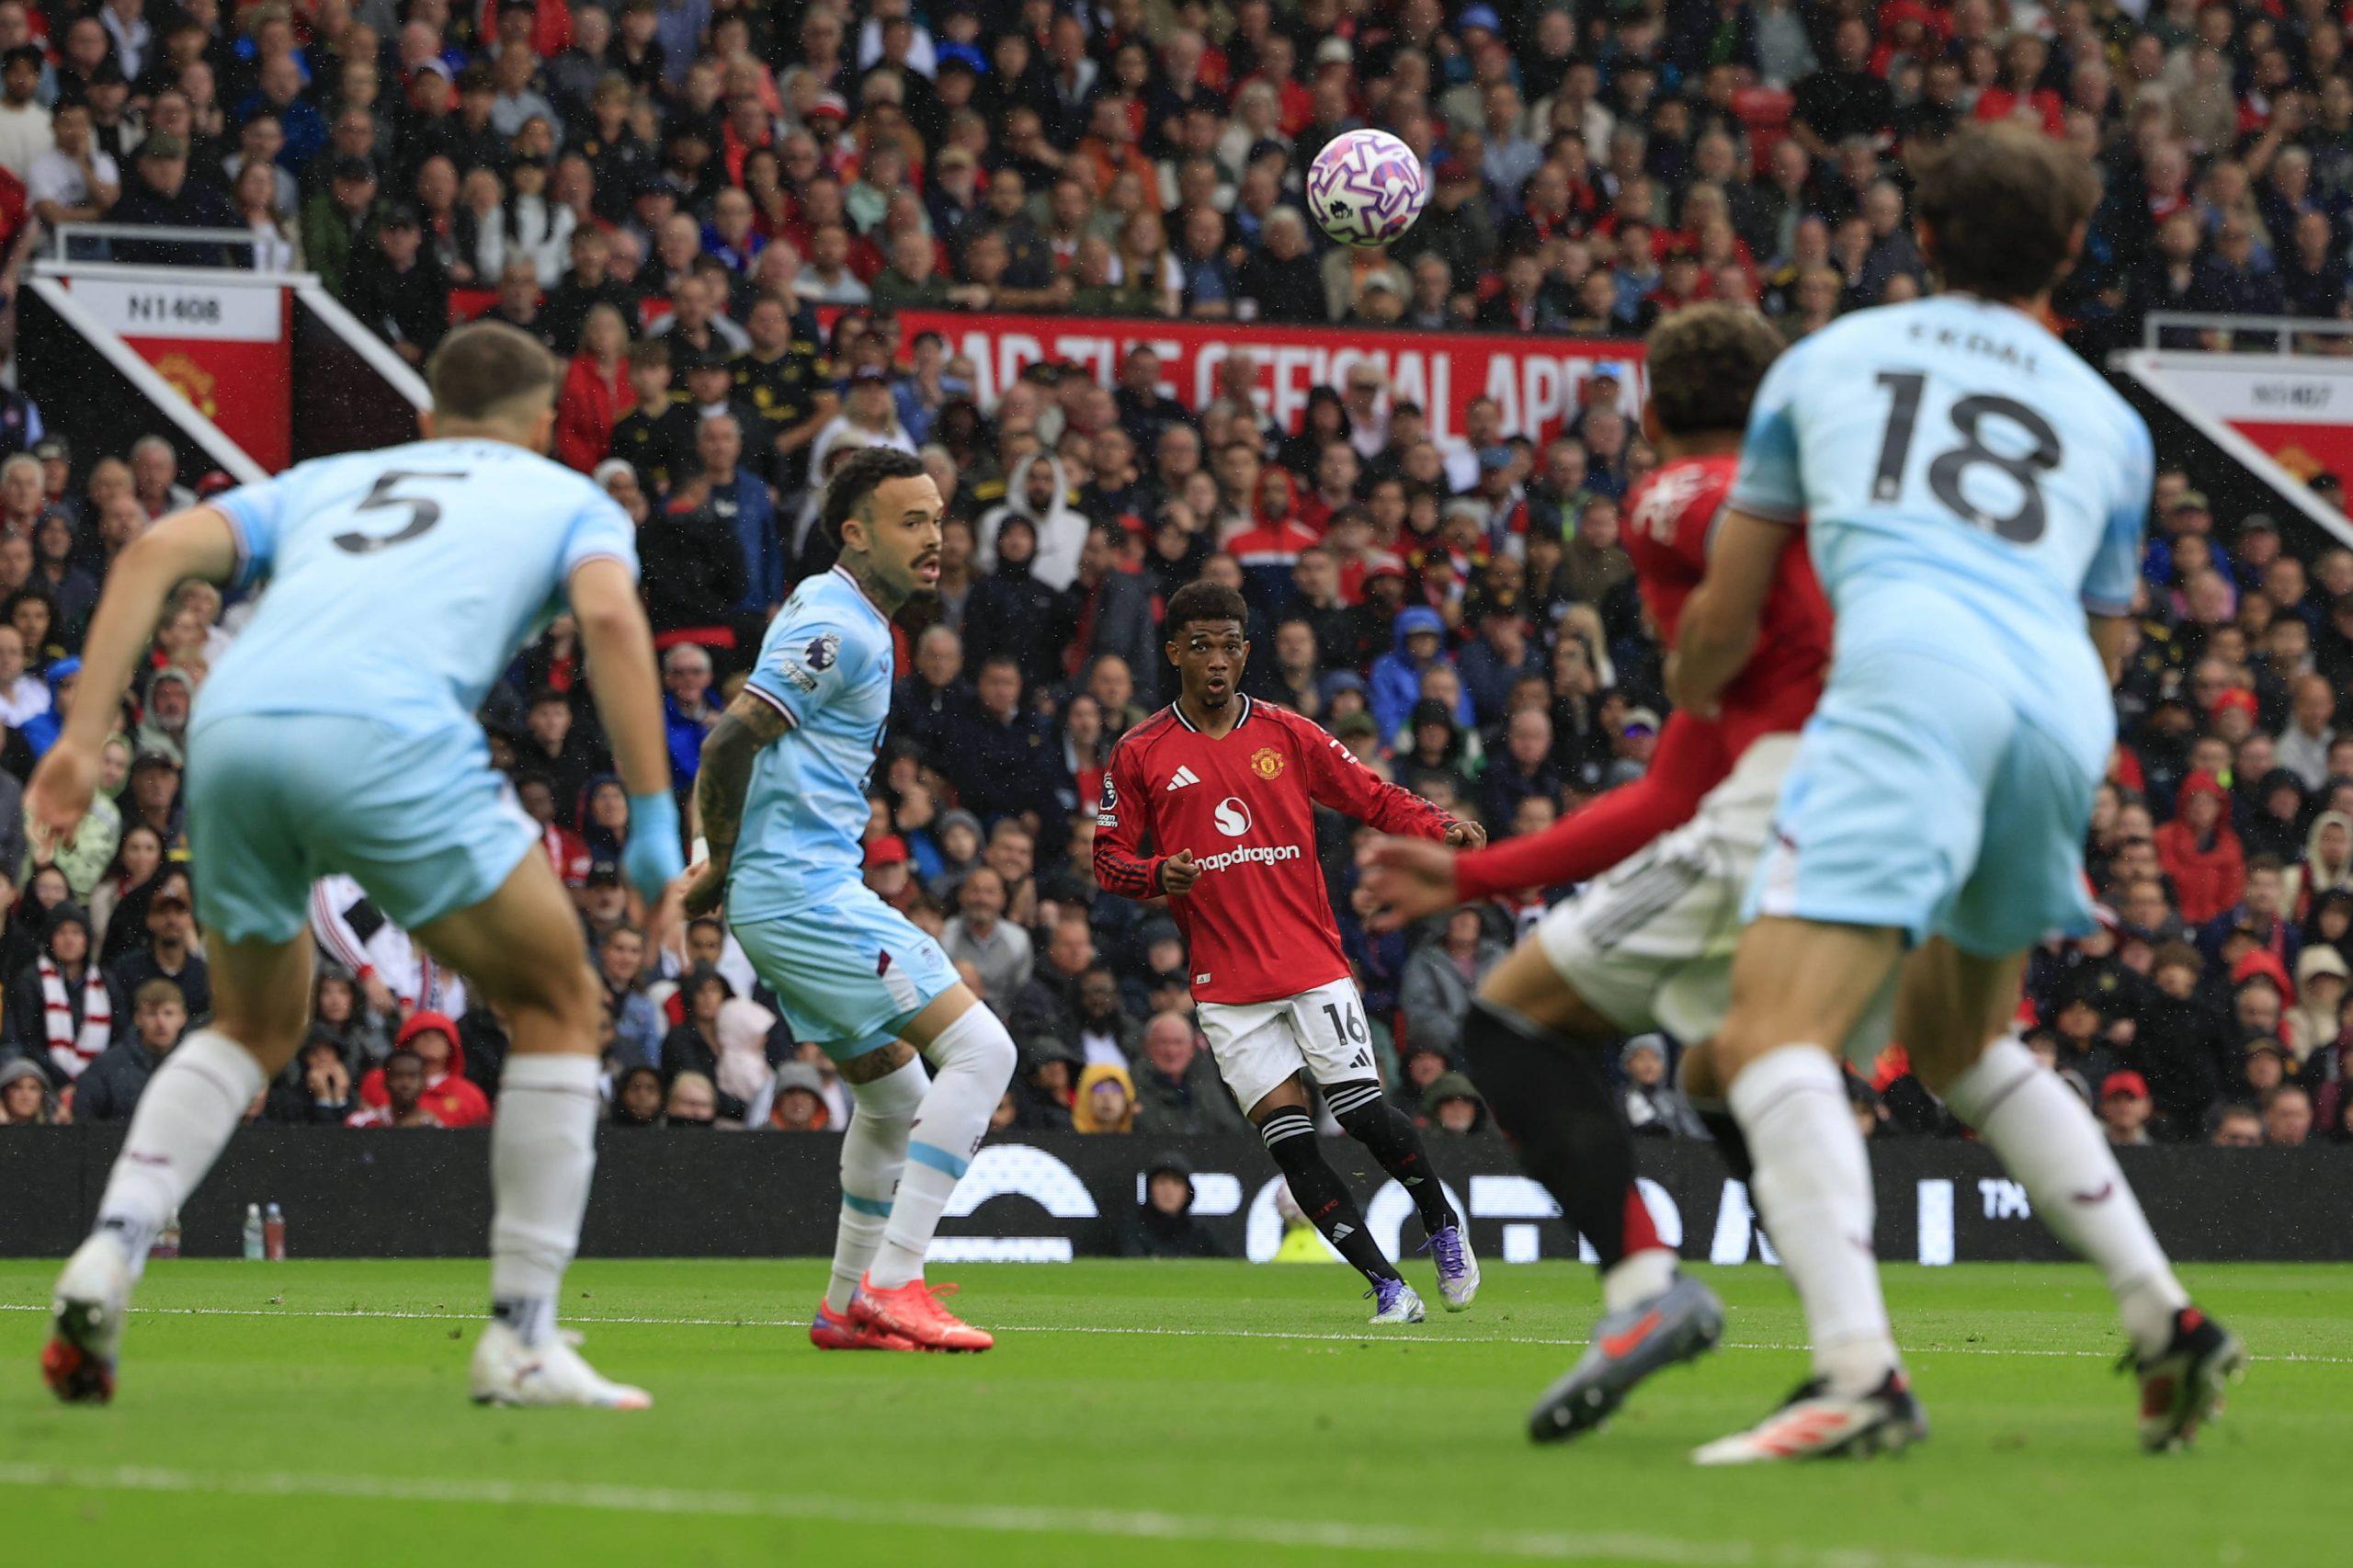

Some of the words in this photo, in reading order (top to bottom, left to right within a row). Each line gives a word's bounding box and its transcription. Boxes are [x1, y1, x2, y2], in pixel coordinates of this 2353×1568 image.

[129, 295, 221, 324] N1408
[1870, 371, 2062, 544] 18
[333, 470, 467, 555] 5
[1193, 844, 1301, 872] napdragon
[1322, 1002, 1368, 1046] 16
